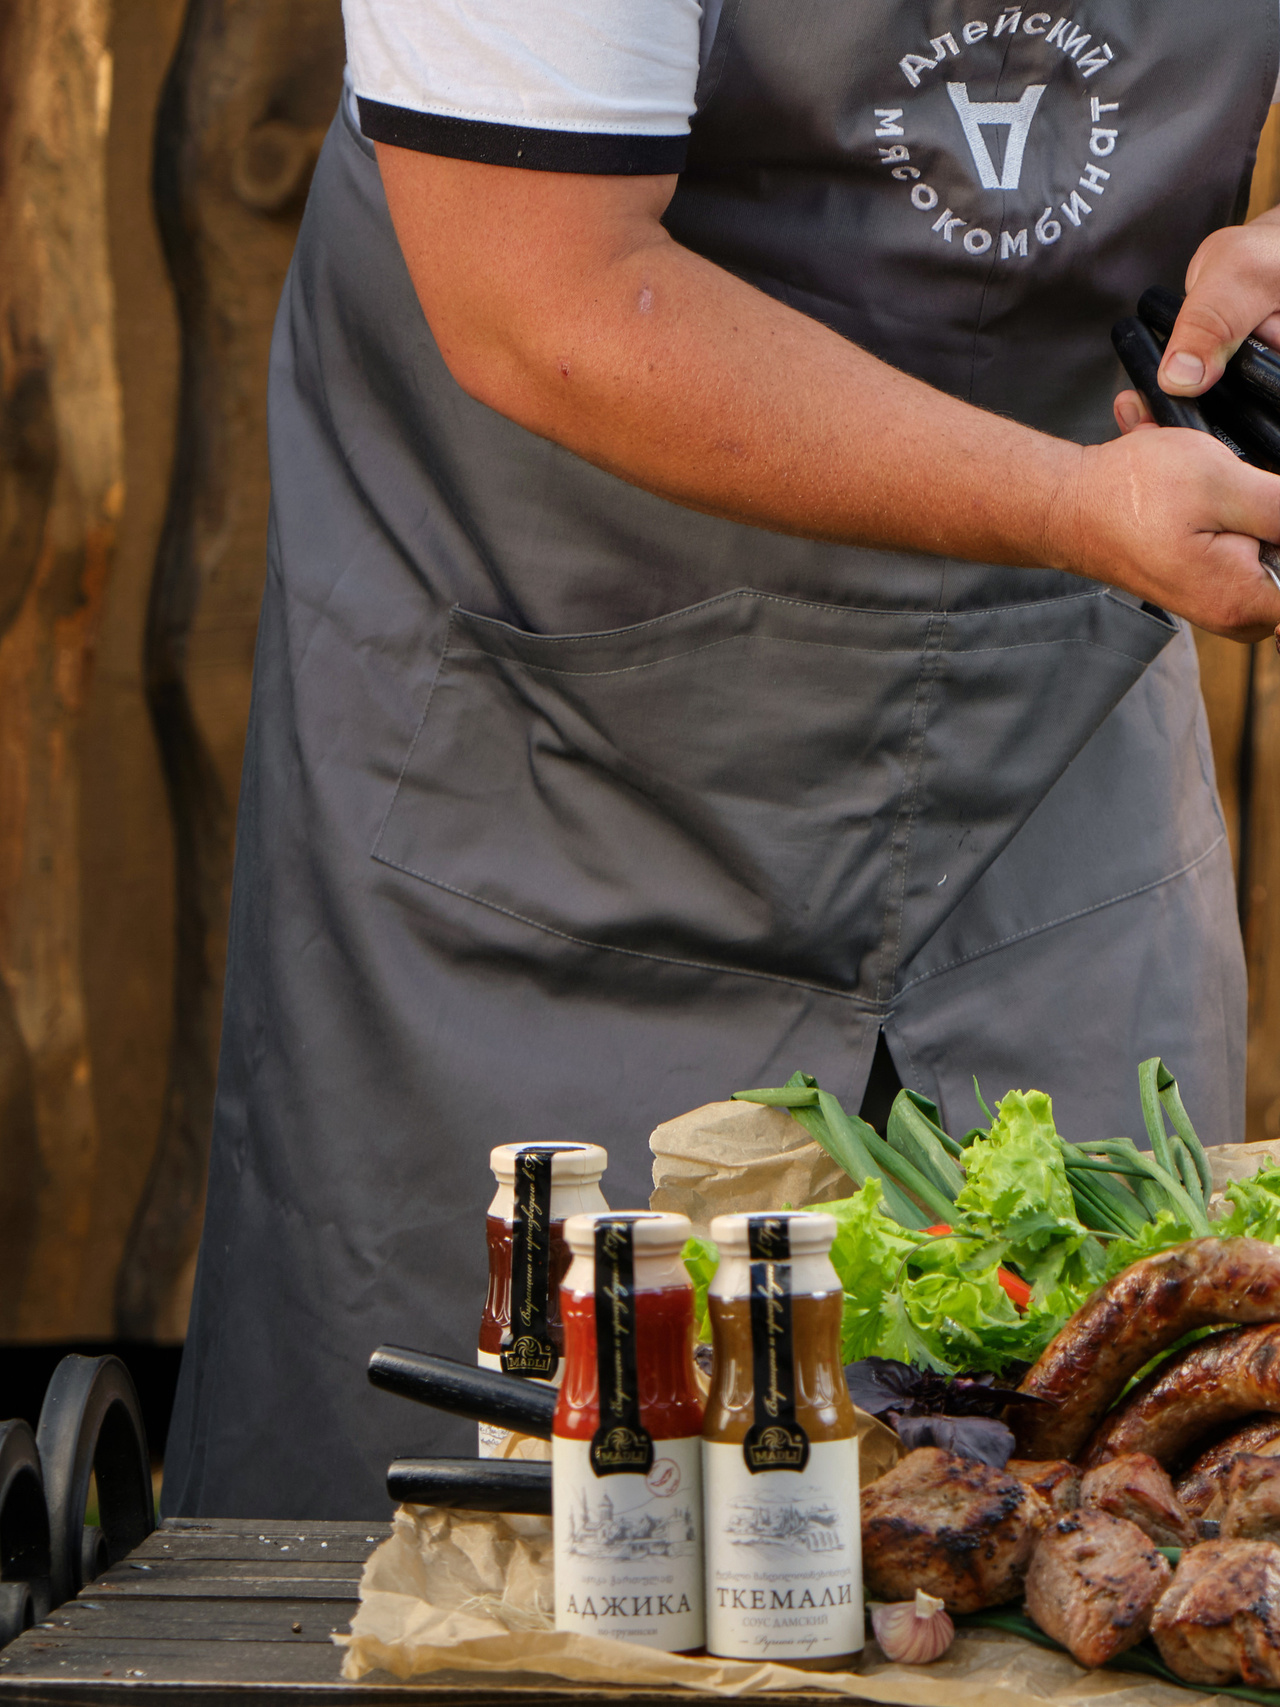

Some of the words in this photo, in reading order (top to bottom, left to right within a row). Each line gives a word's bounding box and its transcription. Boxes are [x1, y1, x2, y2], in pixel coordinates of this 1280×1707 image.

[508, 1357, 547, 1368] MADLI
[602, 1450, 643, 1462] MADLI
[755, 1451, 799, 1462] MADLI
[716, 1583, 852, 1610] ТКЕМАЛИ
[566, 1593, 692, 1620] АДЖИКА
[742, 1615, 771, 1627] СОУС
